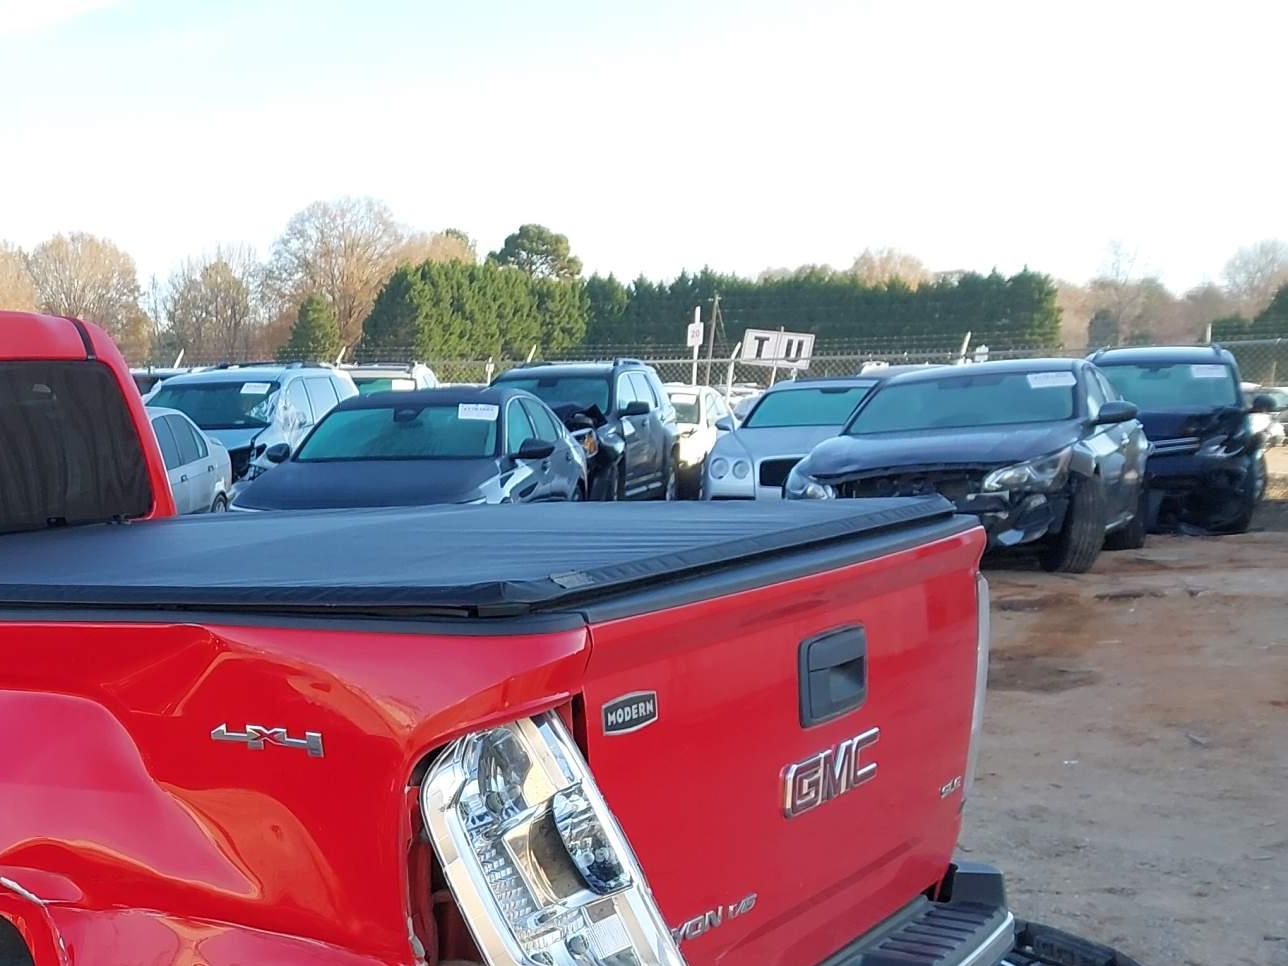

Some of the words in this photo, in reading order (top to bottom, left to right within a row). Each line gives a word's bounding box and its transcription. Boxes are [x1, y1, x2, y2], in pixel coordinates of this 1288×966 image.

[754, 336, 770, 358] T
[607, 699, 654, 726] MODERN
[780, 727, 880, 818] GMC
